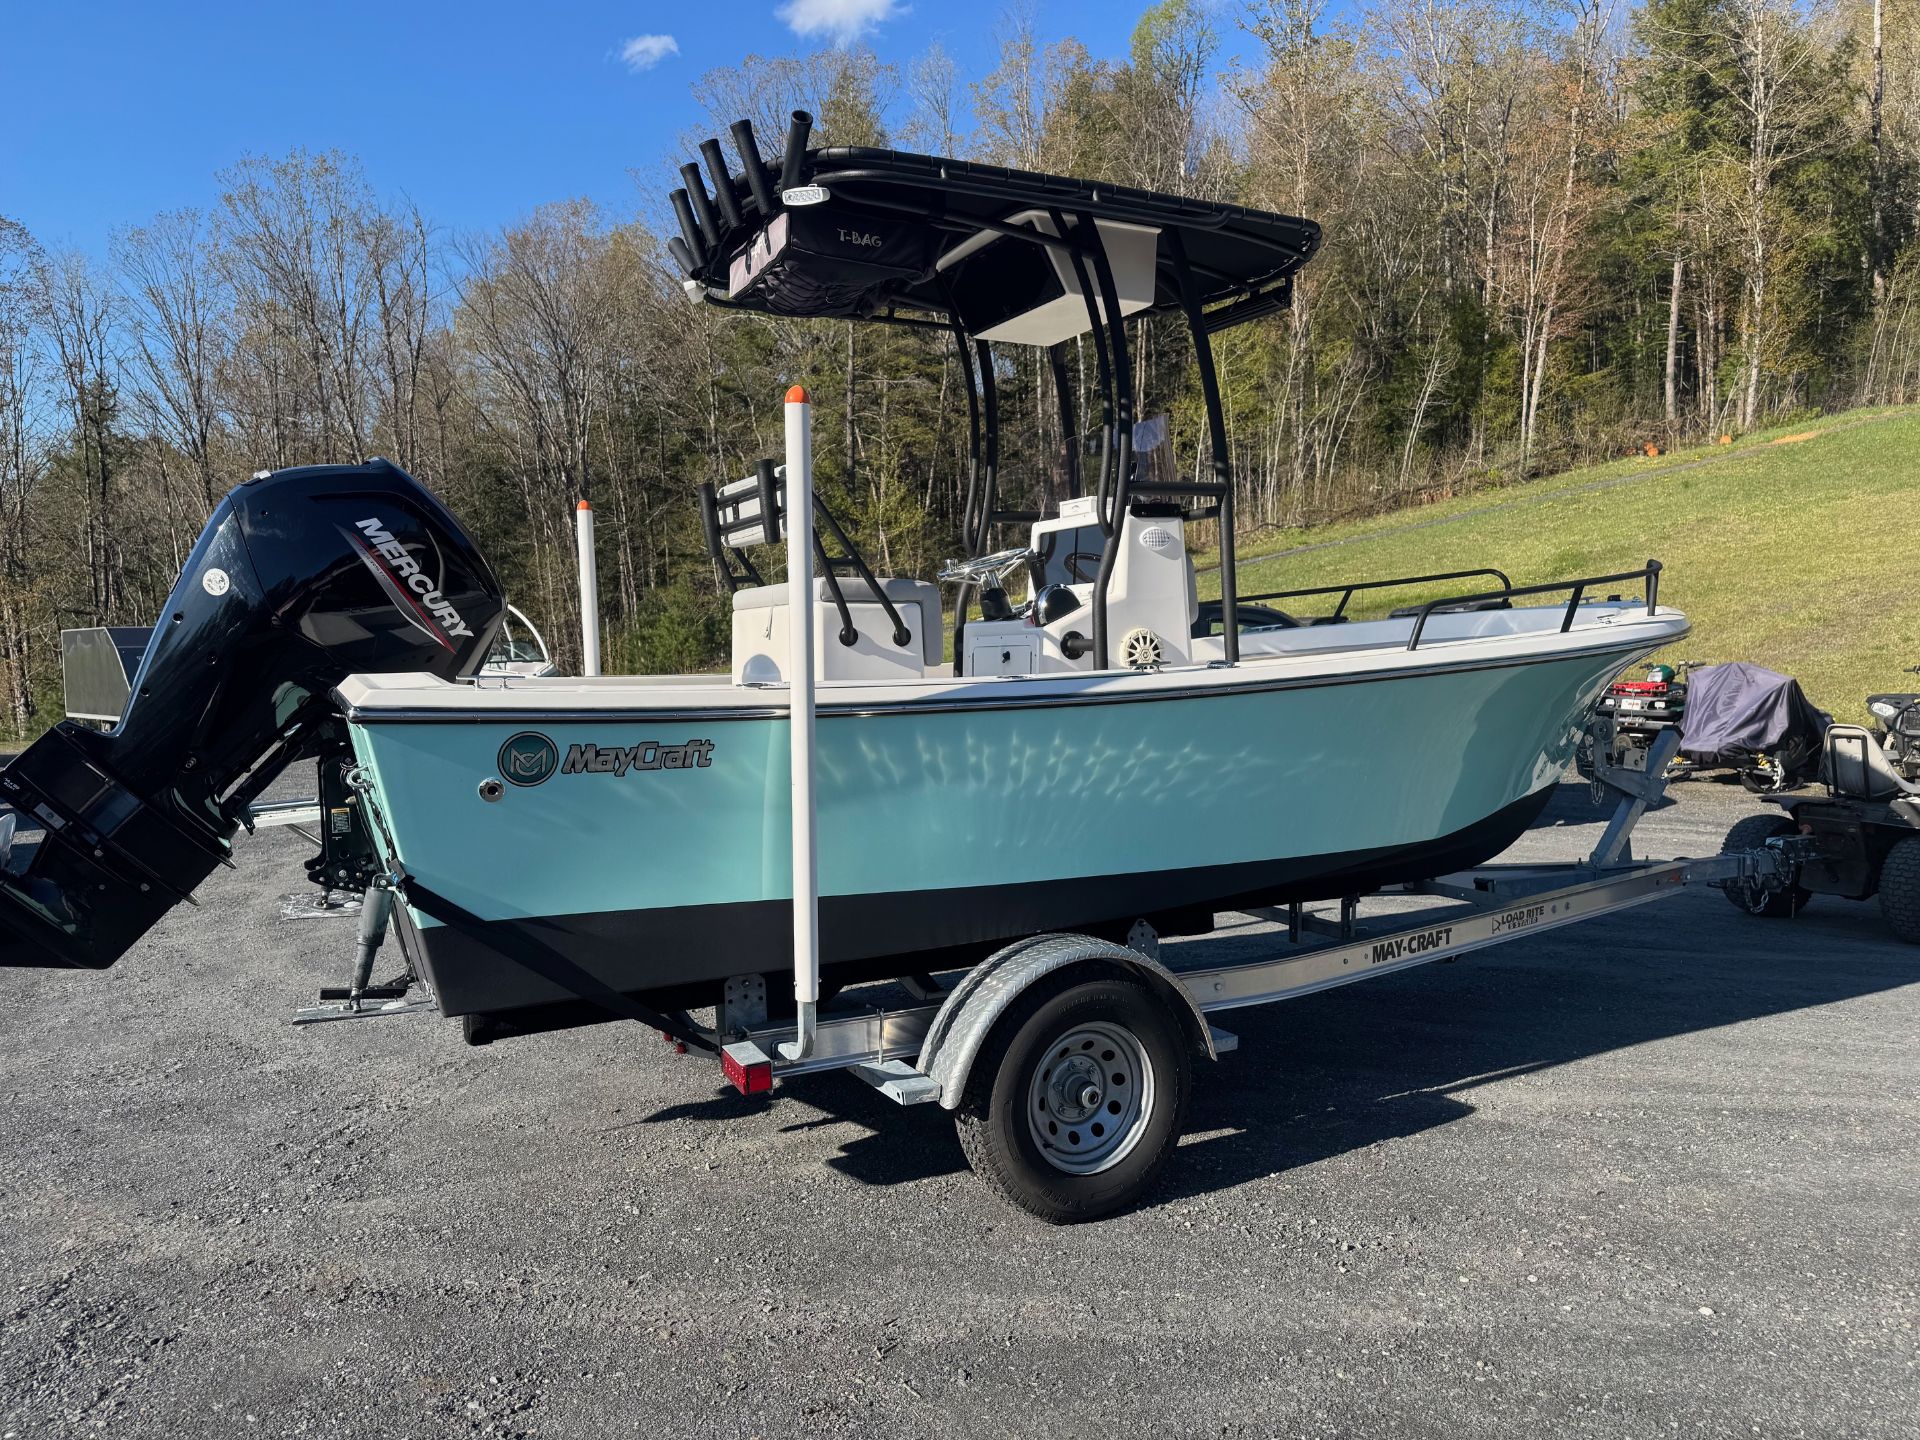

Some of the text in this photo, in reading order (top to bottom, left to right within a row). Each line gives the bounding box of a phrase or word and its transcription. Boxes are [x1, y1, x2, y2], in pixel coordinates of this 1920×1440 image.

[837, 227, 882, 248] T-BAG
[355, 517, 474, 637] MERCURY
[561, 739, 715, 777] MayCraft
[1501, 910, 1525, 925] LOAD
[1526, 905, 1545, 919] RITE
[1372, 928, 1453, 964] MAY-CRAFT
